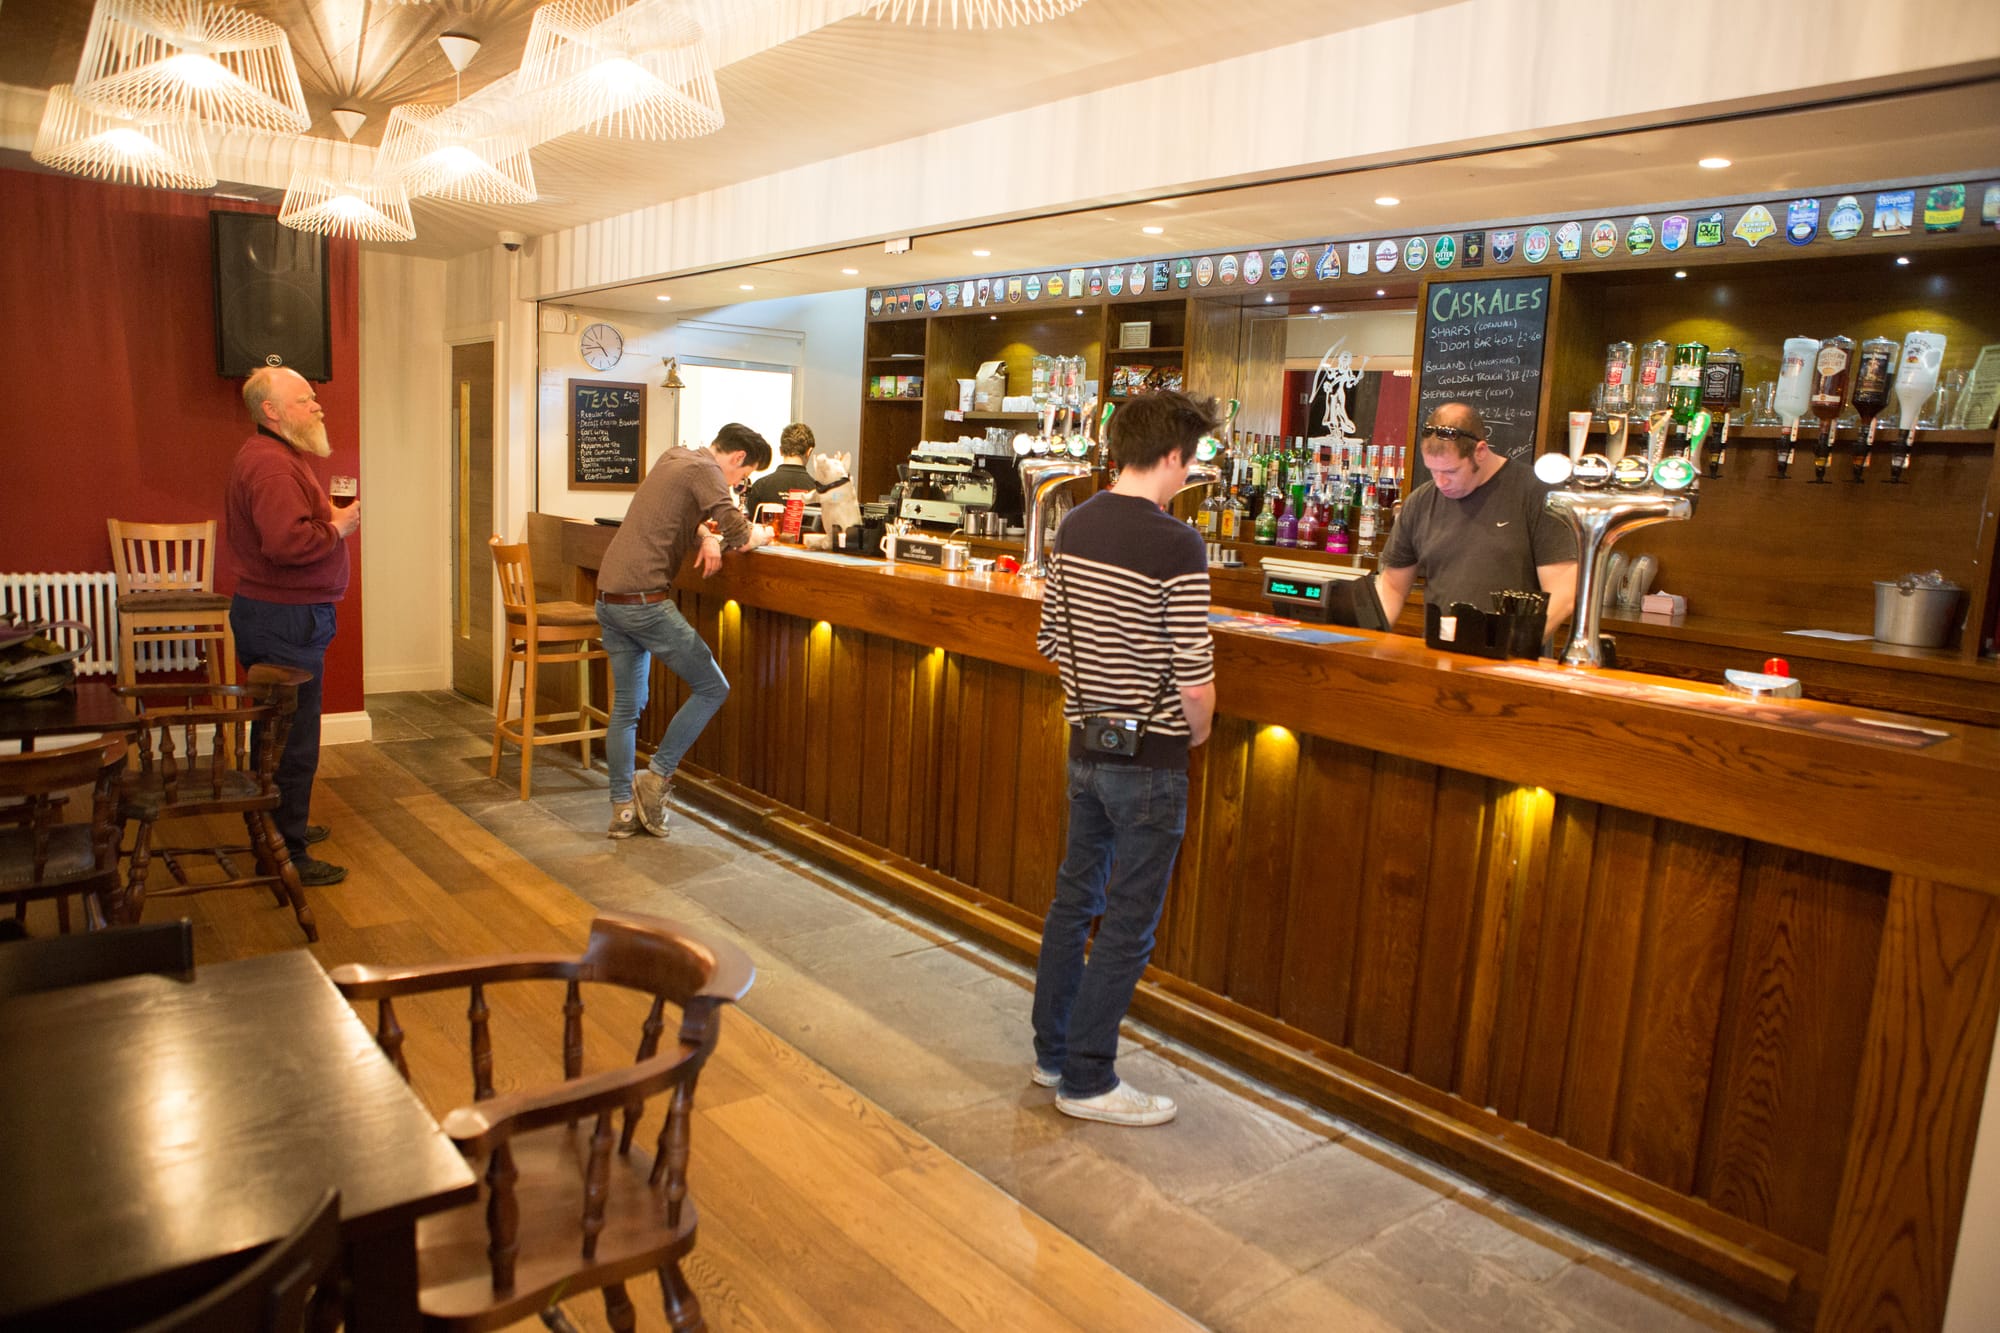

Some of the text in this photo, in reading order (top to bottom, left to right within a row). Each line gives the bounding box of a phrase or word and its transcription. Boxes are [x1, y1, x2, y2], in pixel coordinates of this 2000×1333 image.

[1699, 224, 1718, 233] OUT
[1527, 236, 1546, 250] XB
[1434, 251, 1454, 259] OTTER
[1432, 287, 1543, 322] CASK ALES
[1430, 324, 1471, 339] SHARPS
